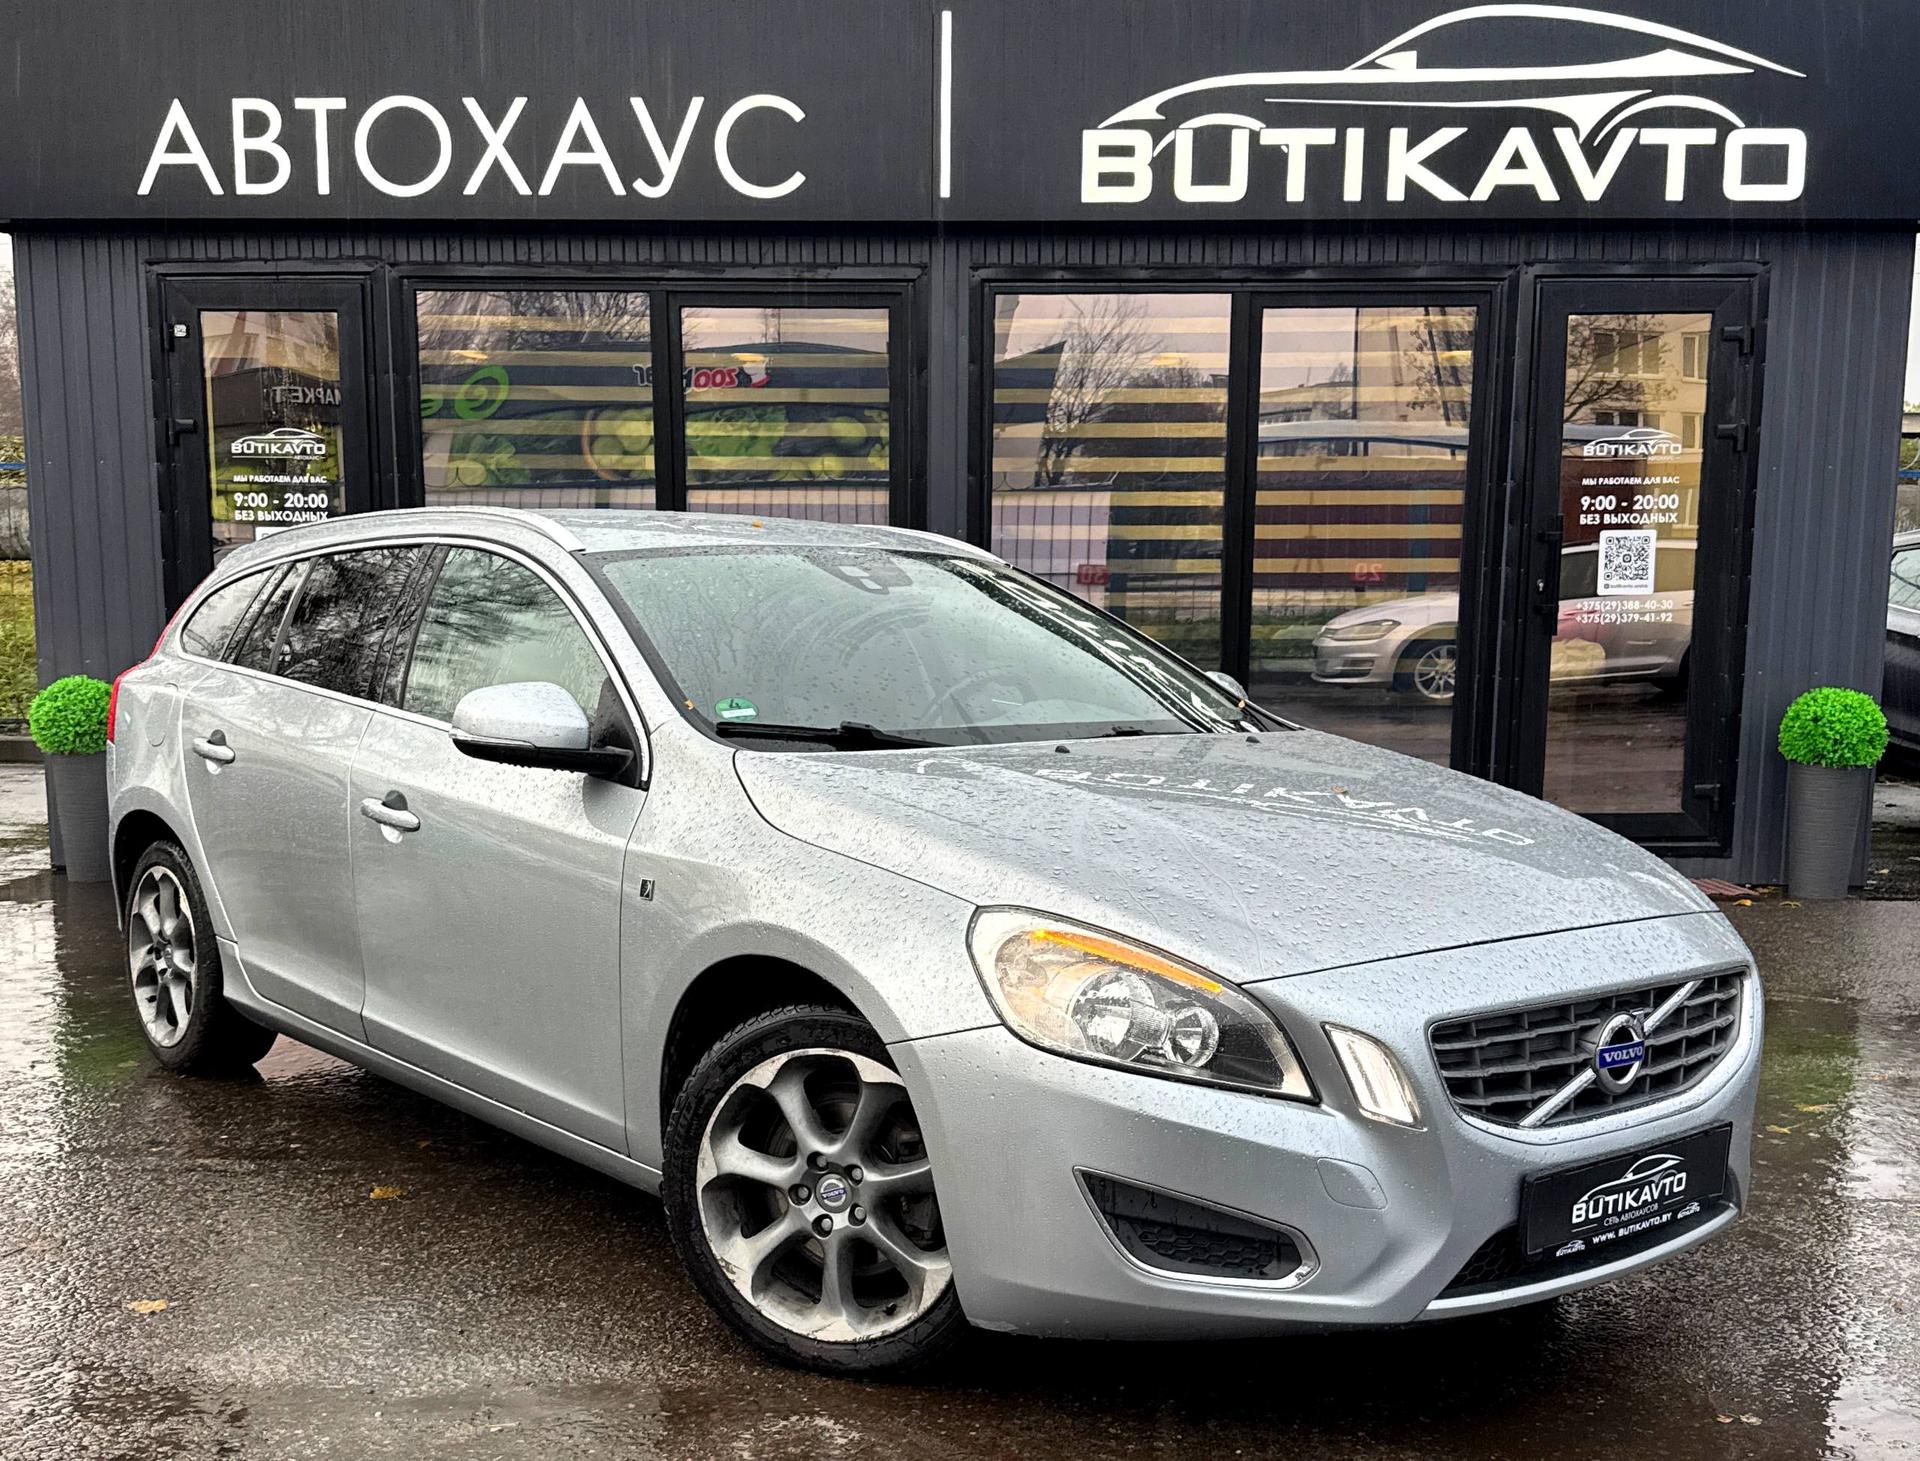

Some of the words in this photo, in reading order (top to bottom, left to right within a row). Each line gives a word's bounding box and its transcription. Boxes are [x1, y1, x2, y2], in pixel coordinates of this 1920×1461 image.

[136, 94, 807, 199] АВТОХАУС
[1080, 124, 1808, 203] BUTIKAVTO
[231, 441, 326, 454] BUTIKAVTO
[1583, 443, 1682, 457] BUTIKAVTO
[249, 475, 291, 483] РАБОТАЕМ
[292, 476, 309, 484] ДЛЯ
[310, 476, 328, 484] ВАС
[1582, 477, 1597, 486] МЫ
[1598, 476, 1642, 486] РАБОТАЕМ
[1643, 476, 1661, 486] ДЛЯ
[1662, 475, 1681, 485] ВАС
[234, 492, 268, 507] 9:00
[283, 492, 328, 508] 20:00
[1580, 495, 1617, 511] 9:00
[1632, 494, 1680, 510] 20:00
[234, 510, 255, 521] БЕЗ
[257, 510, 329, 522] ВЫХОДНЫХ
[1579, 513, 1601, 525] БЕЗ
[1603, 512, 1678, 525] ВЫХОДНЫХ
[1575, 612, 1673, 625] +375(29)379-41-92
[1603, 1046, 1643, 1063] VOLVO
[1571, 1171, 1687, 1224] BUTIKAVTO
[1603, 1215, 1620, 1227] СЕТЬ
[1620, 1203, 1659, 1222] АВТОХАУСОВ
[1592, 1232, 1617, 1244] WWW.
[1618, 1212, 1673, 1237] BUTIKAVTO.BY
